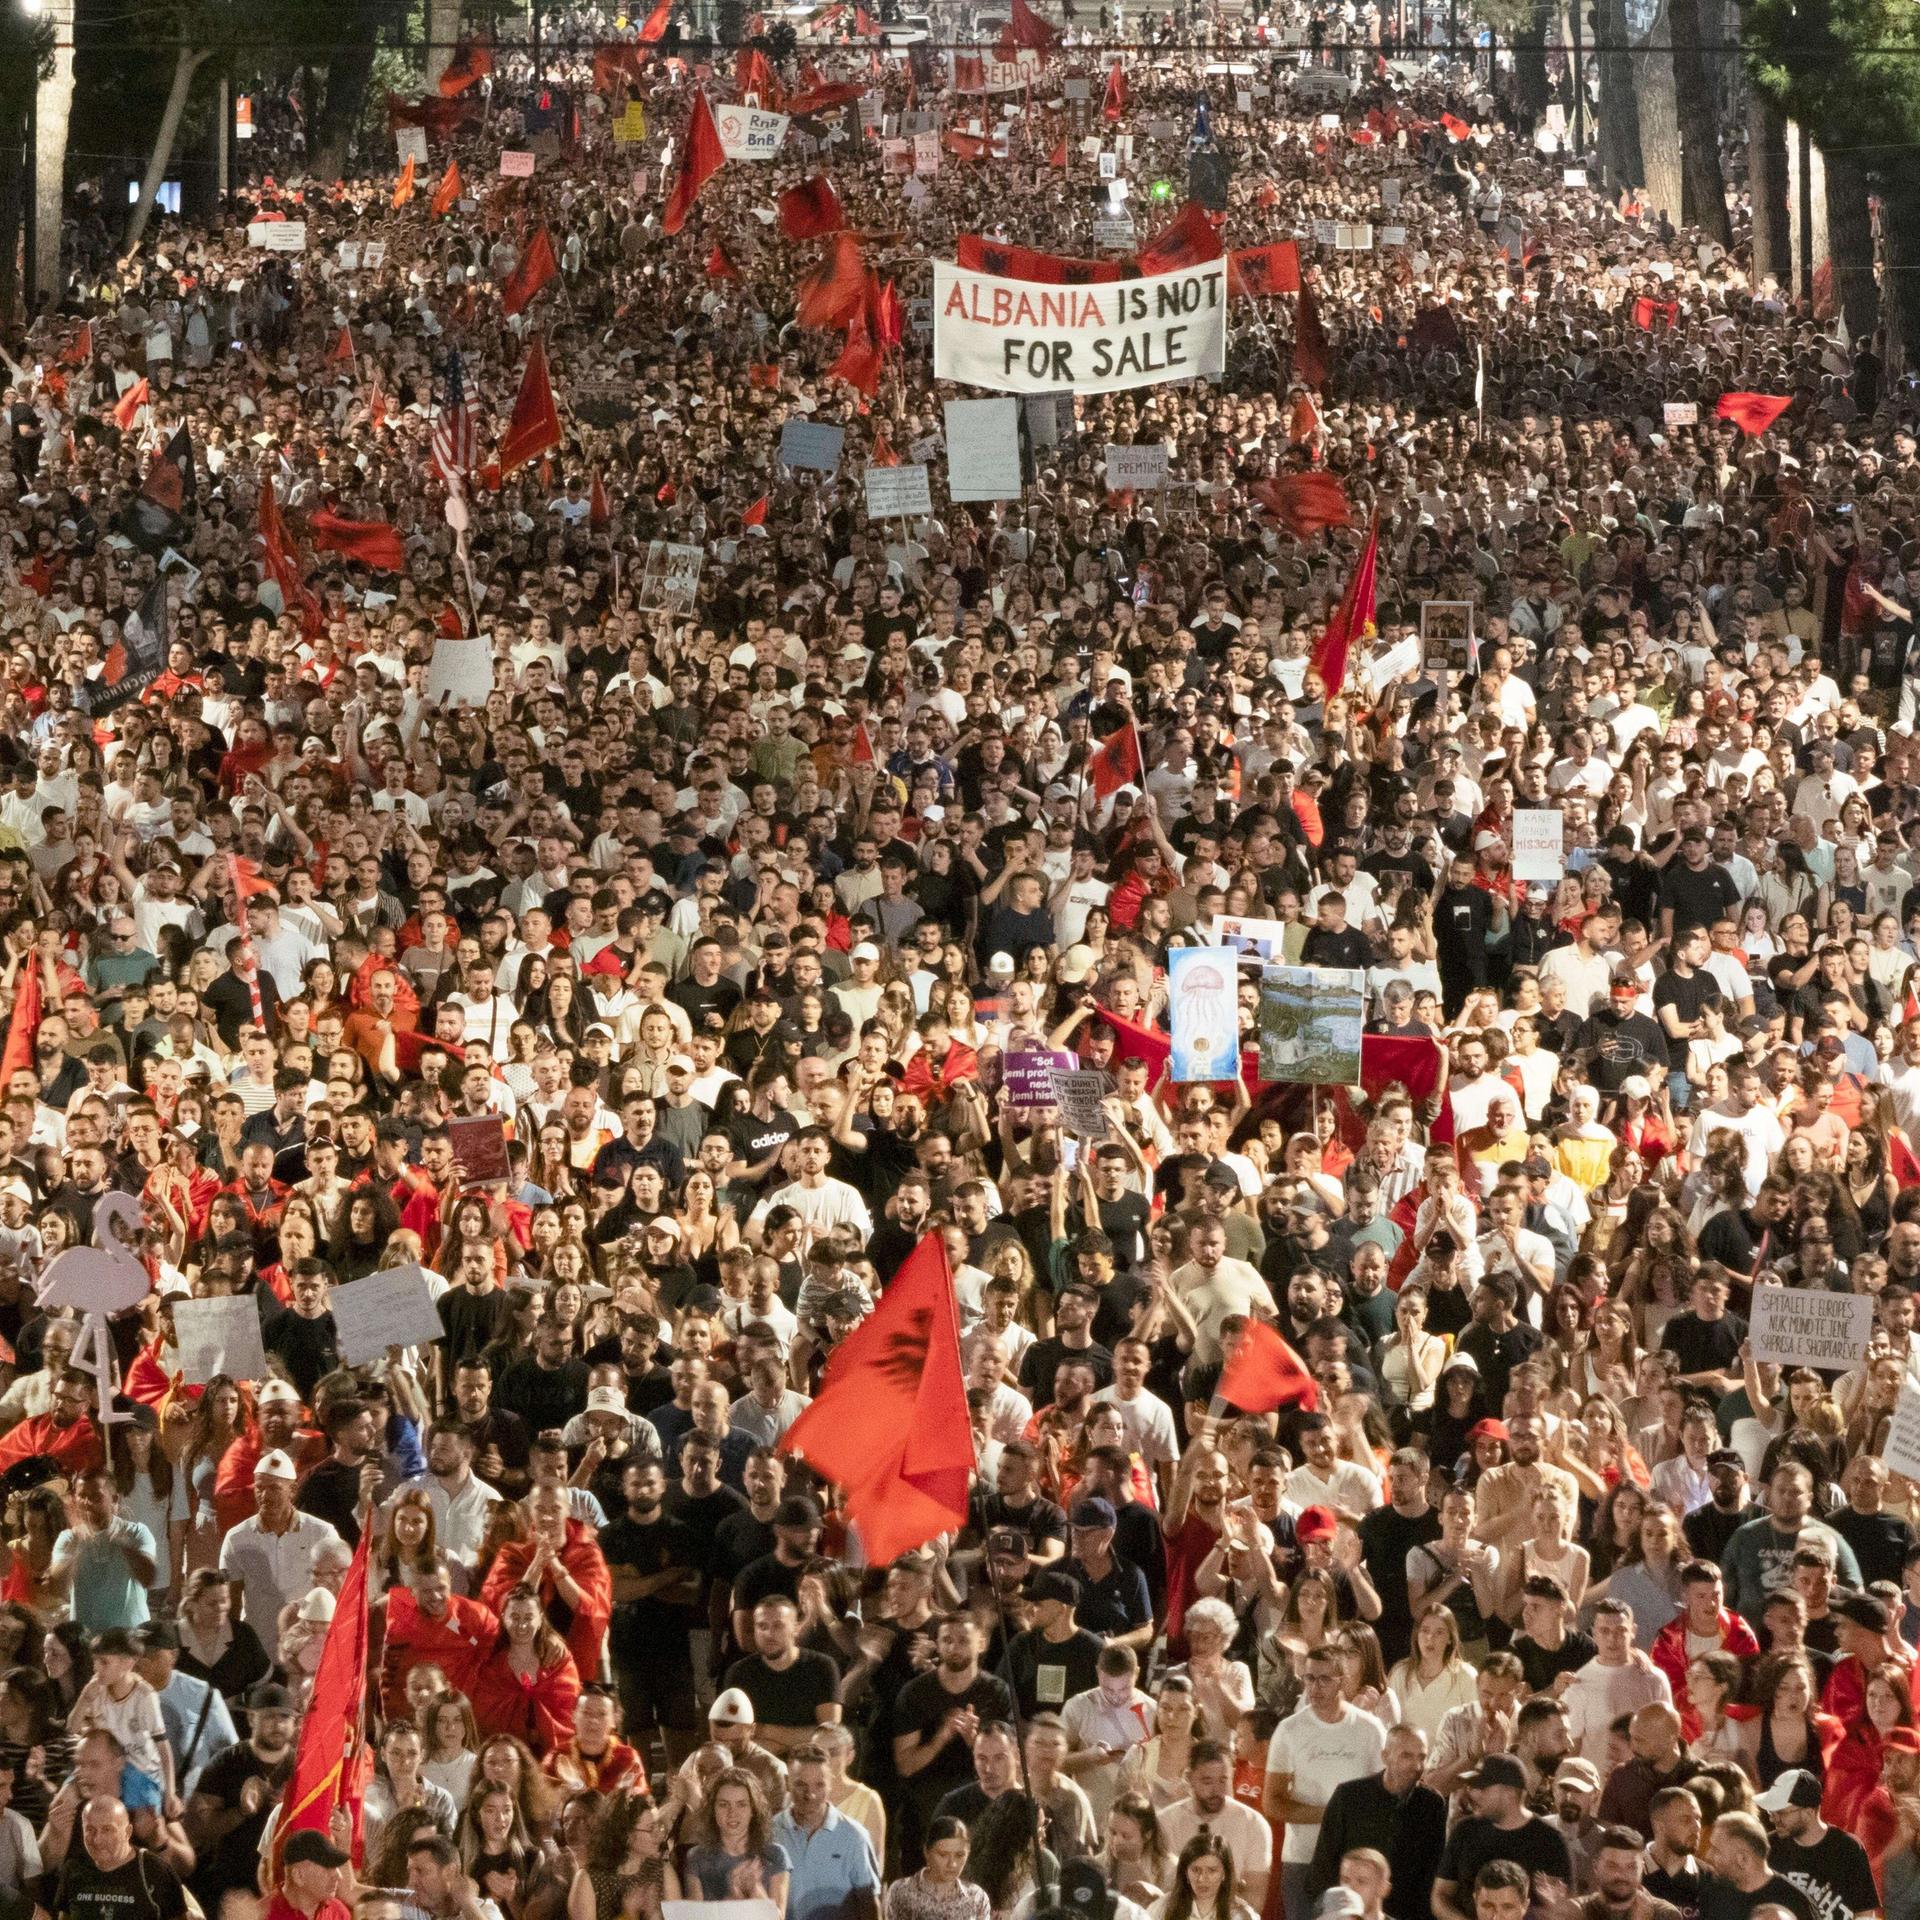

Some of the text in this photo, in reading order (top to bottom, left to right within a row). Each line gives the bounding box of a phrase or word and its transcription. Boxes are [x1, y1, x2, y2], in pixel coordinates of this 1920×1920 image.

[750, 114, 780, 128] RnB
[747, 133, 775, 146] BnB
[944, 271, 1223, 328] ALBANIA IS NOT
[1003, 325, 1188, 381] FOR SALE
[751, 1131, 790, 1149] adidas
[1761, 1293, 1805, 1315] SPITALET
[1809, 1298, 1815, 1316] E
[1768, 1315, 1788, 1333] NUK
[1760, 1334, 1794, 1354] SHPRESA
[1797, 1337, 1803, 1355] E
[76, 1893, 93, 1902] ONE
